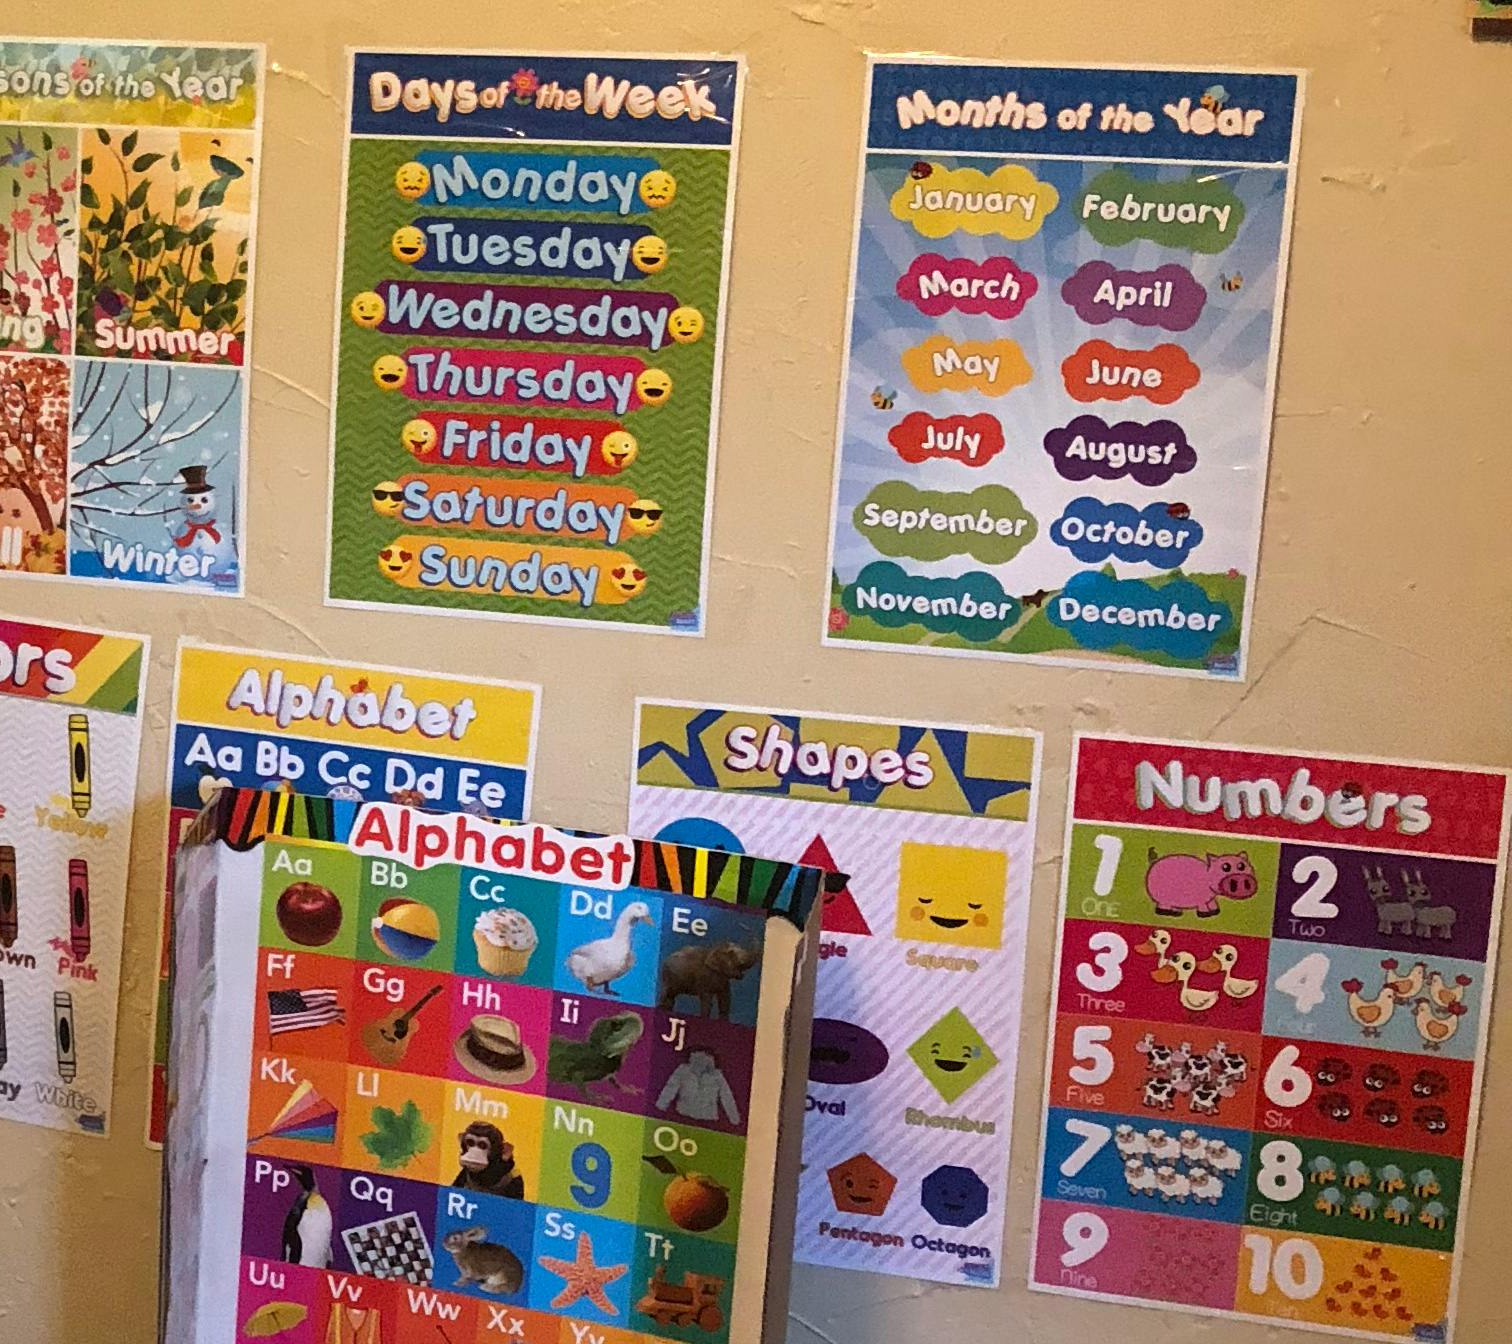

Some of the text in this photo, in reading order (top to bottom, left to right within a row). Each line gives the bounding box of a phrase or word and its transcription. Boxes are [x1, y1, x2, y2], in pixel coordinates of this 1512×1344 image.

[79, 75, 104, 97] of
[112, 75, 155, 99] the
[164, 67, 244, 103] Year
[369, 71, 717, 122] Days of the Week
[896, 89, 1265, 137] Months of the Year
[431, 155, 636, 214] Monday
[907, 182, 1036, 222] January
[1081, 193, 1231, 232] February
[426, 222, 633, 282] Tuesday
[918, 271, 1021, 303] March
[1092, 279, 1172, 310] April
[387, 283, 669, 351] Wednesday
[94, 317, 236, 357] Summer
[408, 351, 634, 415] Thursday
[932, 349, 1000, 382] May
[1085, 358, 1162, 389] June
[441, 419, 592, 477] Friday
[920, 425, 981, 460] July
[1064, 435, 1178, 468] August
[402, 480, 628, 544] Saturday
[862, 501, 1028, 538] September
[1060, 517, 1189, 550] October
[102, 540, 216, 579] Winter
[419, 544, 599, 606] Sunday
[855, 586, 1011, 621] November
[1059, 596, 1221, 632] December
[228, 668, 476, 740] Alphabet
[185, 733, 506, 808] Aa Bb Cc Dd Ee
[725, 724, 935, 789] Shapes
[1135, 760, 1432, 835] Numbers
[36, 805, 108, 839] Yellow
[272, 850, 313, 876] Aa
[355, 806, 632, 886] Alphabet
[371, 861, 408, 891] Bb
[1093, 834, 1124, 897] 1
[570, 891, 613, 921] Dd
[1290, 856, 1339, 919] 2
[672, 907, 708, 938] Ee
[1288, 920, 1326, 937] Two
[57, 957, 99, 982] Pink
[906, 948, 979, 973] Square
[1076, 931, 1129, 993] 3
[1274, 952, 1332, 1015] 4
[1077, 994, 1126, 1013] Three
[1068, 1025, 1115, 1086] 5
[1263, 1044, 1313, 1108] 6
[35, 1082, 97, 1113] White
[1066, 1087, 1104, 1106] Five
[905, 1106, 996, 1135] Rhombus
[1263, 1110, 1293, 1128] Six
[1060, 1118, 1111, 1177] 7
[1057, 1179, 1108, 1199] Seven
[1256, 1141, 1305, 1204] 8
[1249, 1203, 1299, 1227] Eight
[819, 1221, 905, 1249] Pentagon
[911, 1234, 991, 1261] Octagon
[1061, 1212, 1110, 1268] 9
[1244, 1234, 1324, 1300] 10
